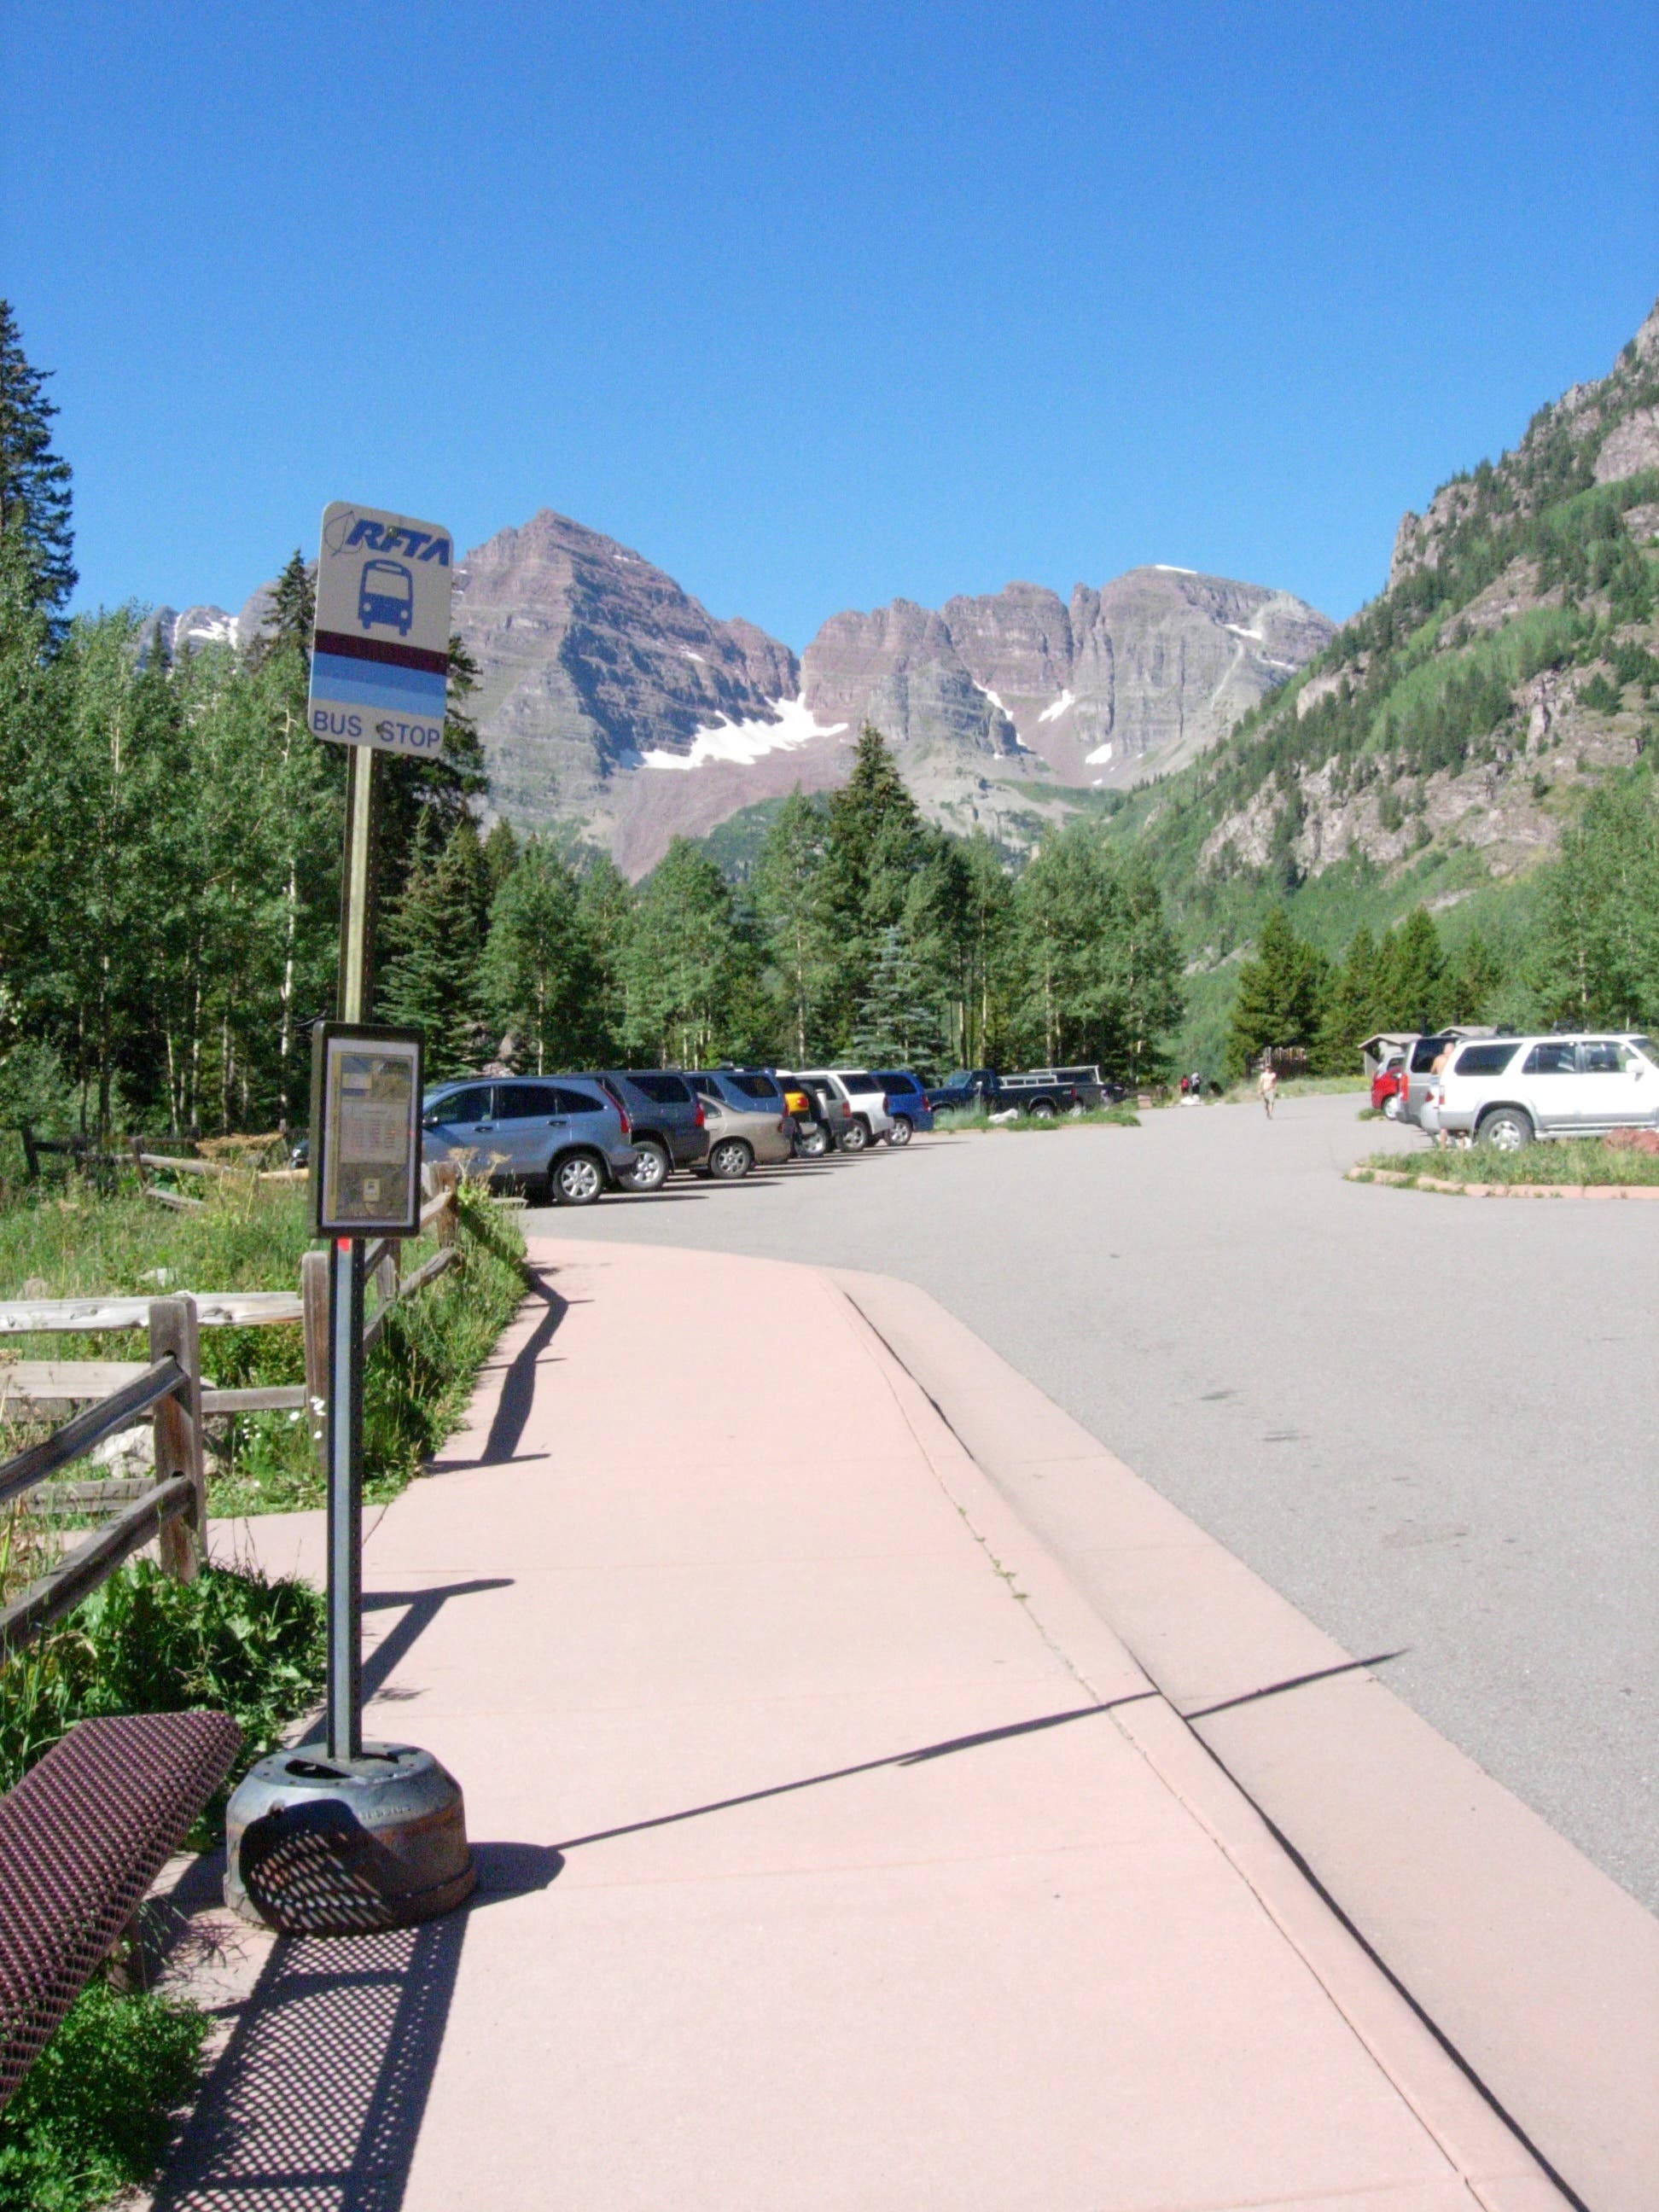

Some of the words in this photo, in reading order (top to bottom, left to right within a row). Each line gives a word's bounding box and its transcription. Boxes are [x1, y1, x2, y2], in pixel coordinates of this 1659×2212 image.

[346, 519, 449, 566] RFTA
[314, 711, 362, 737] BUS
[381, 721, 440, 748] STOP
